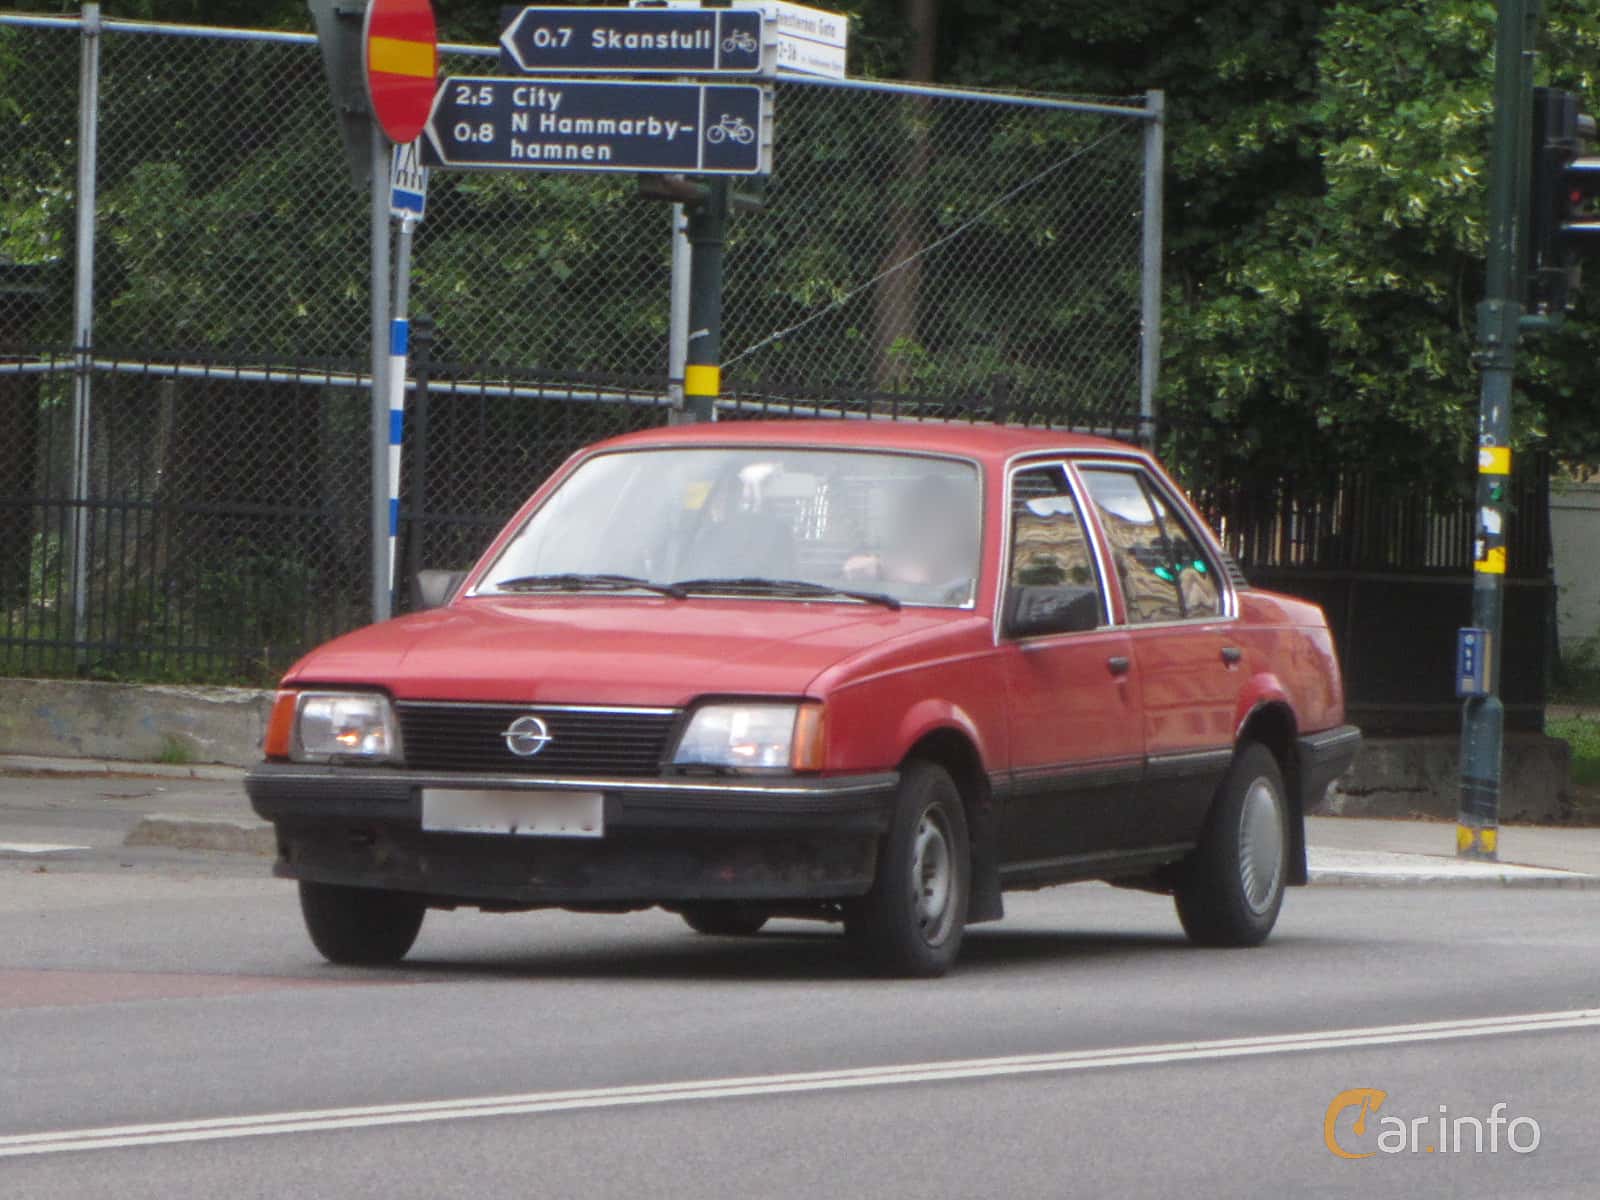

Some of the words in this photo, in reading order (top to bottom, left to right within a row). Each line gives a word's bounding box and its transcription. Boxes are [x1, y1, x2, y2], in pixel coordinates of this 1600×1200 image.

[592, 29, 710, 48] Skanstull
[513, 87, 562, 111] City
[512, 113, 528, 132] N
[540, 113, 694, 141] Hammarby-
[511, 139, 611, 160] hamnen
